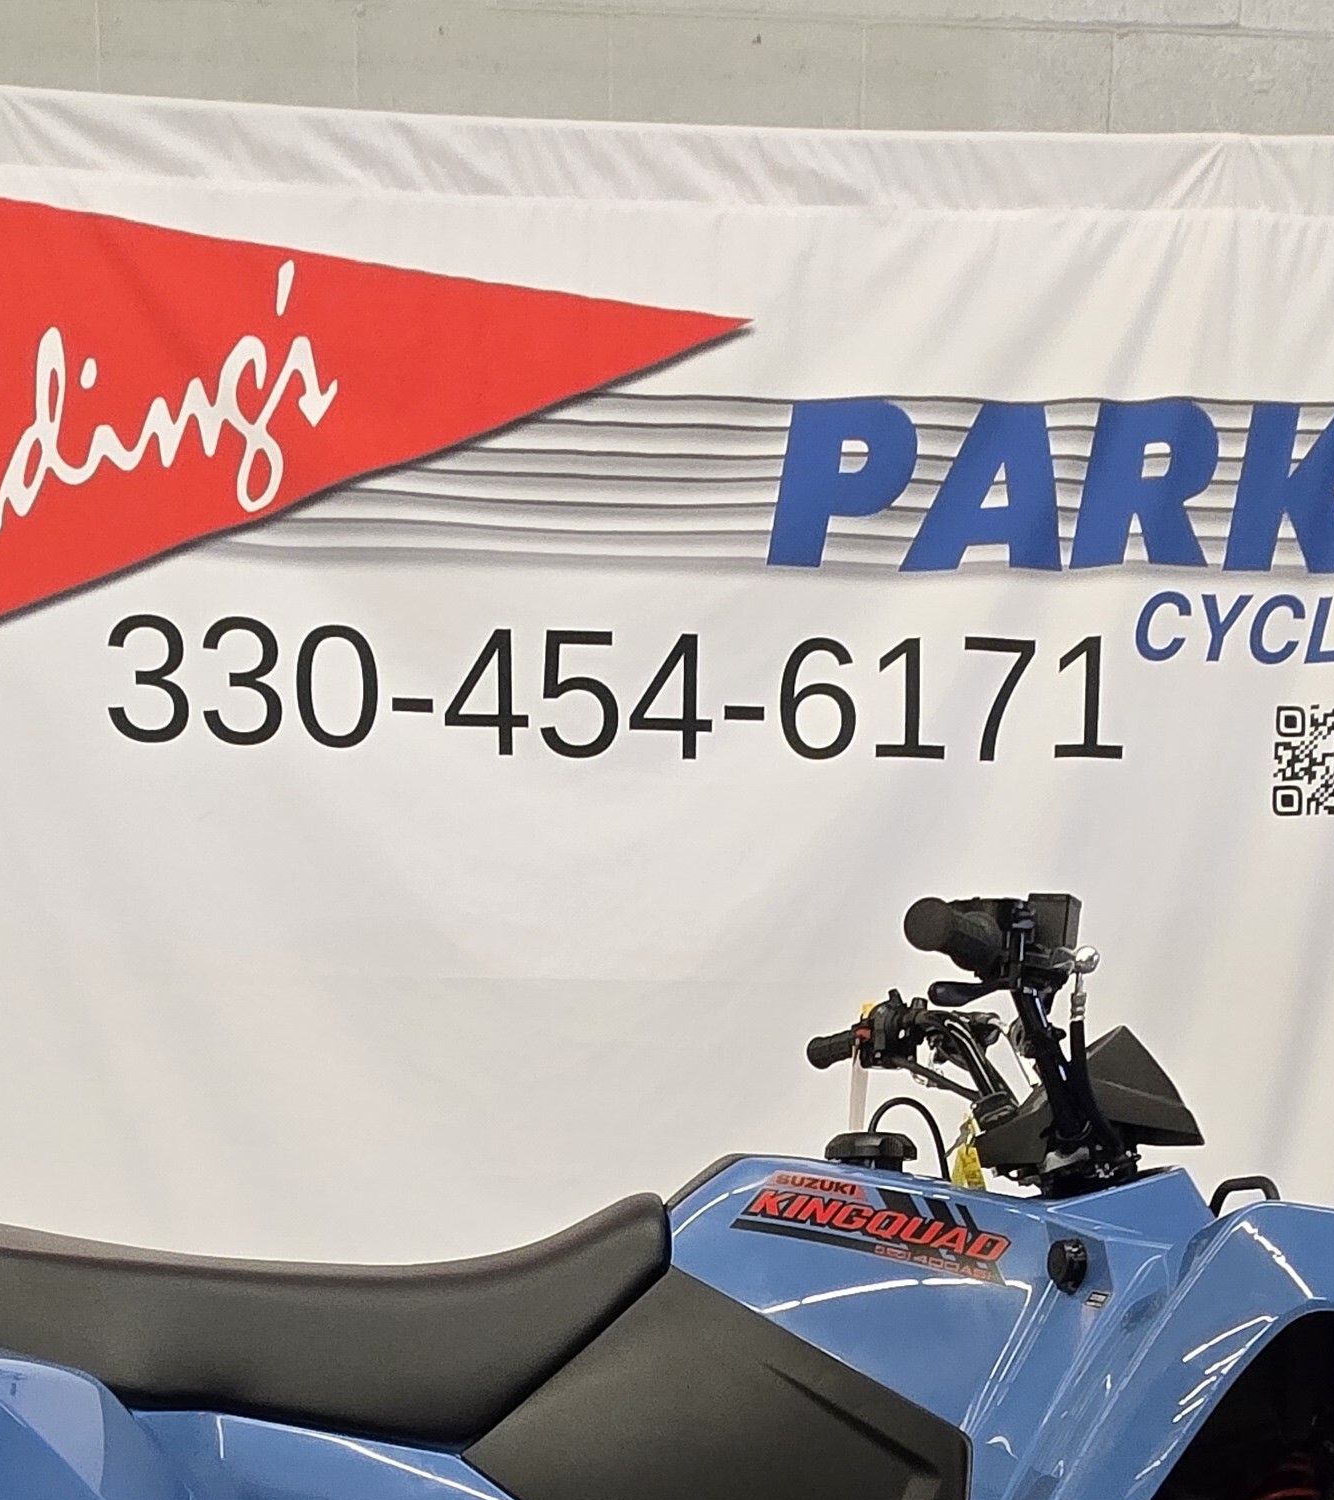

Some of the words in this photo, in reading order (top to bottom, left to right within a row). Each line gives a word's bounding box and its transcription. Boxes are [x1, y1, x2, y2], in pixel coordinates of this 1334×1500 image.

[107, 613, 1124, 763] 330-454-6171
[775, 1173, 858, 1197] SUZUKI
[748, 1190, 1012, 1262] KINGQUAD
